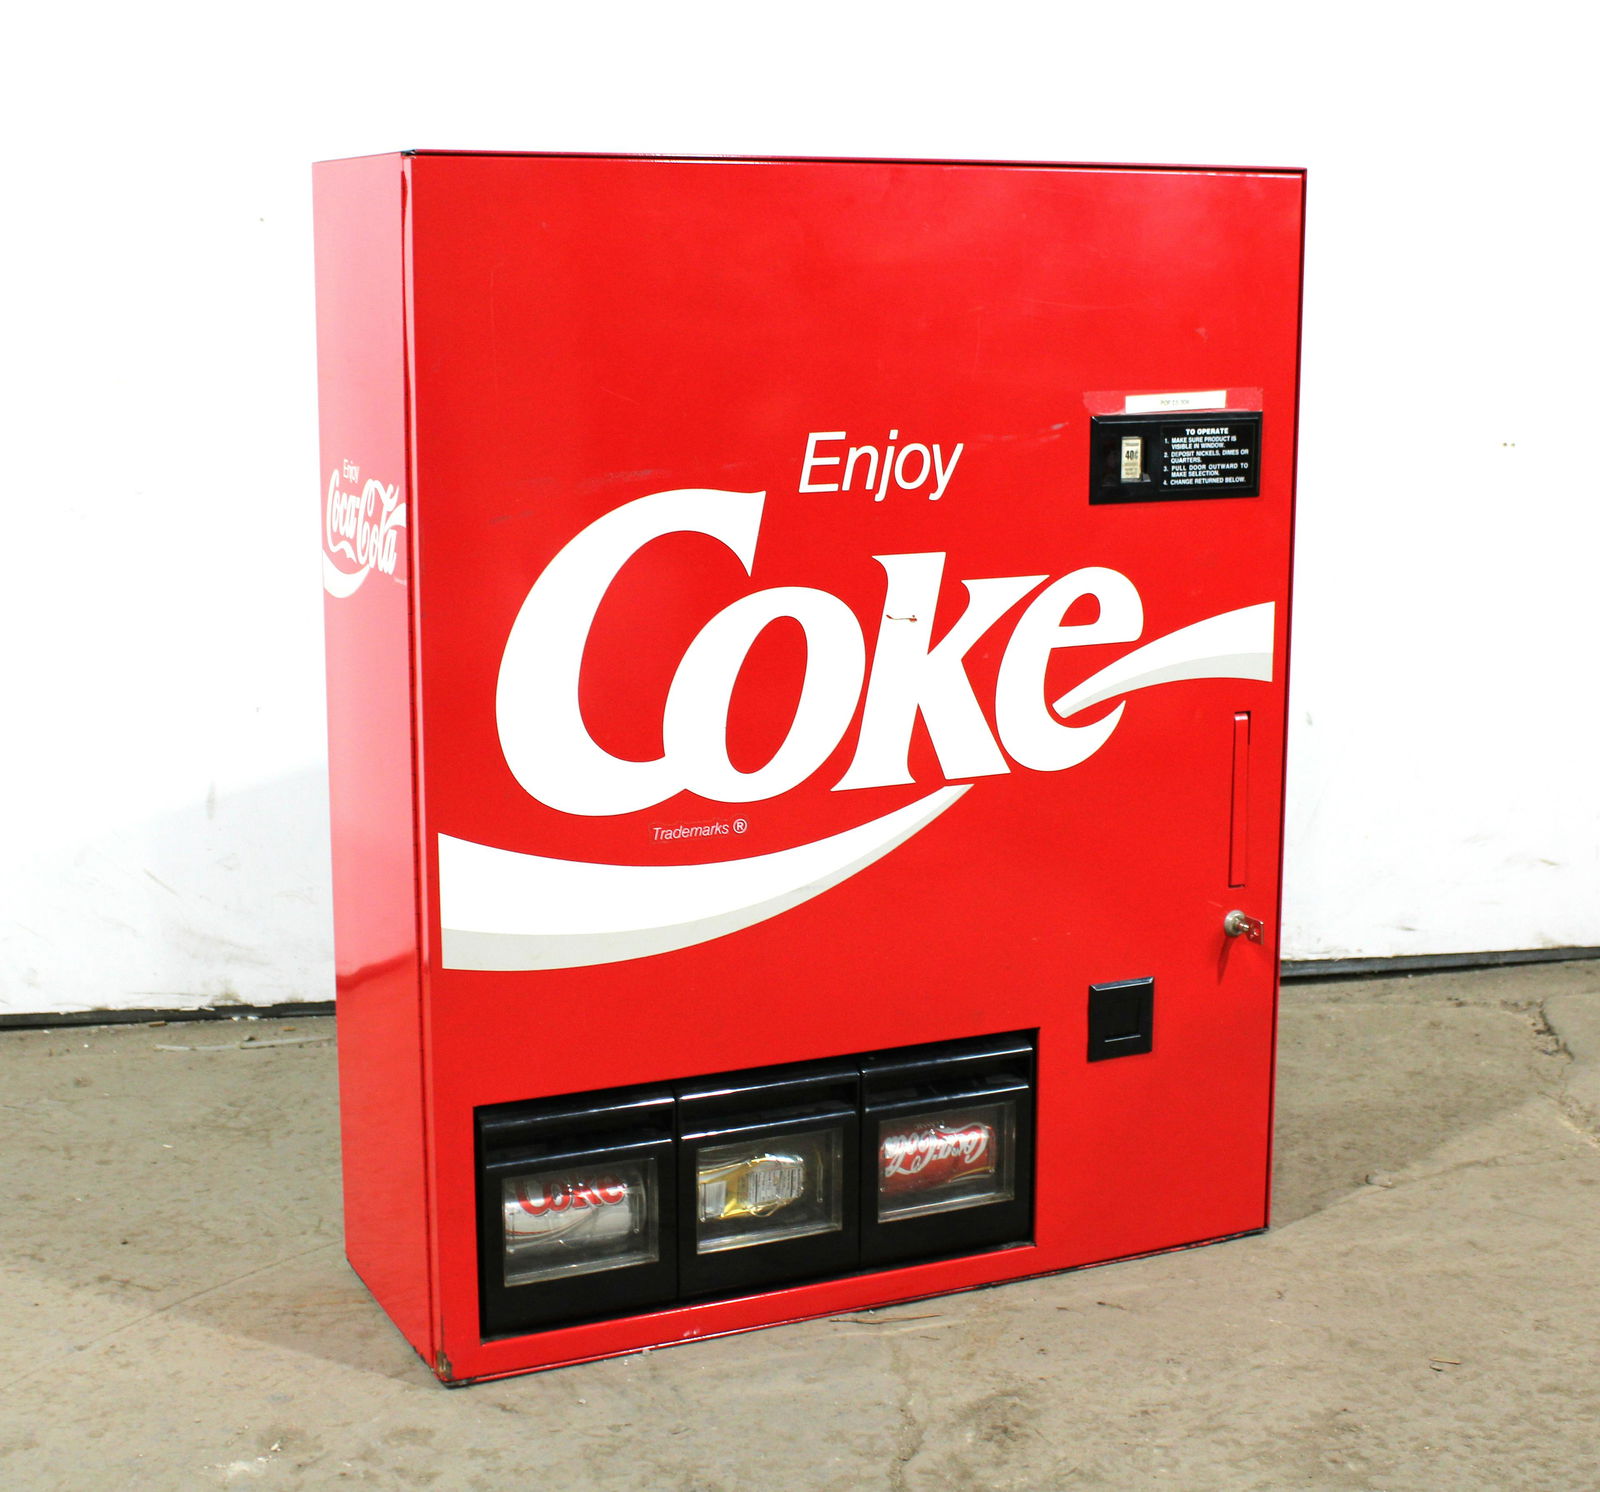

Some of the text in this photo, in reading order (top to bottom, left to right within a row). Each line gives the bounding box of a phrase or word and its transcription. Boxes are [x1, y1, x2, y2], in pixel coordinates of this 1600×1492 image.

[1171, 436, 1188, 444] MAKE
[1197, 427, 1229, 435] OPERATE
[343, 458, 360, 484] Enjoy
[799, 430, 964, 502] Enjoy
[326, 468, 400, 576] Coca-Cola
[495, 489, 1145, 818] Coke
[653, 822, 729, 841] Trademarks
